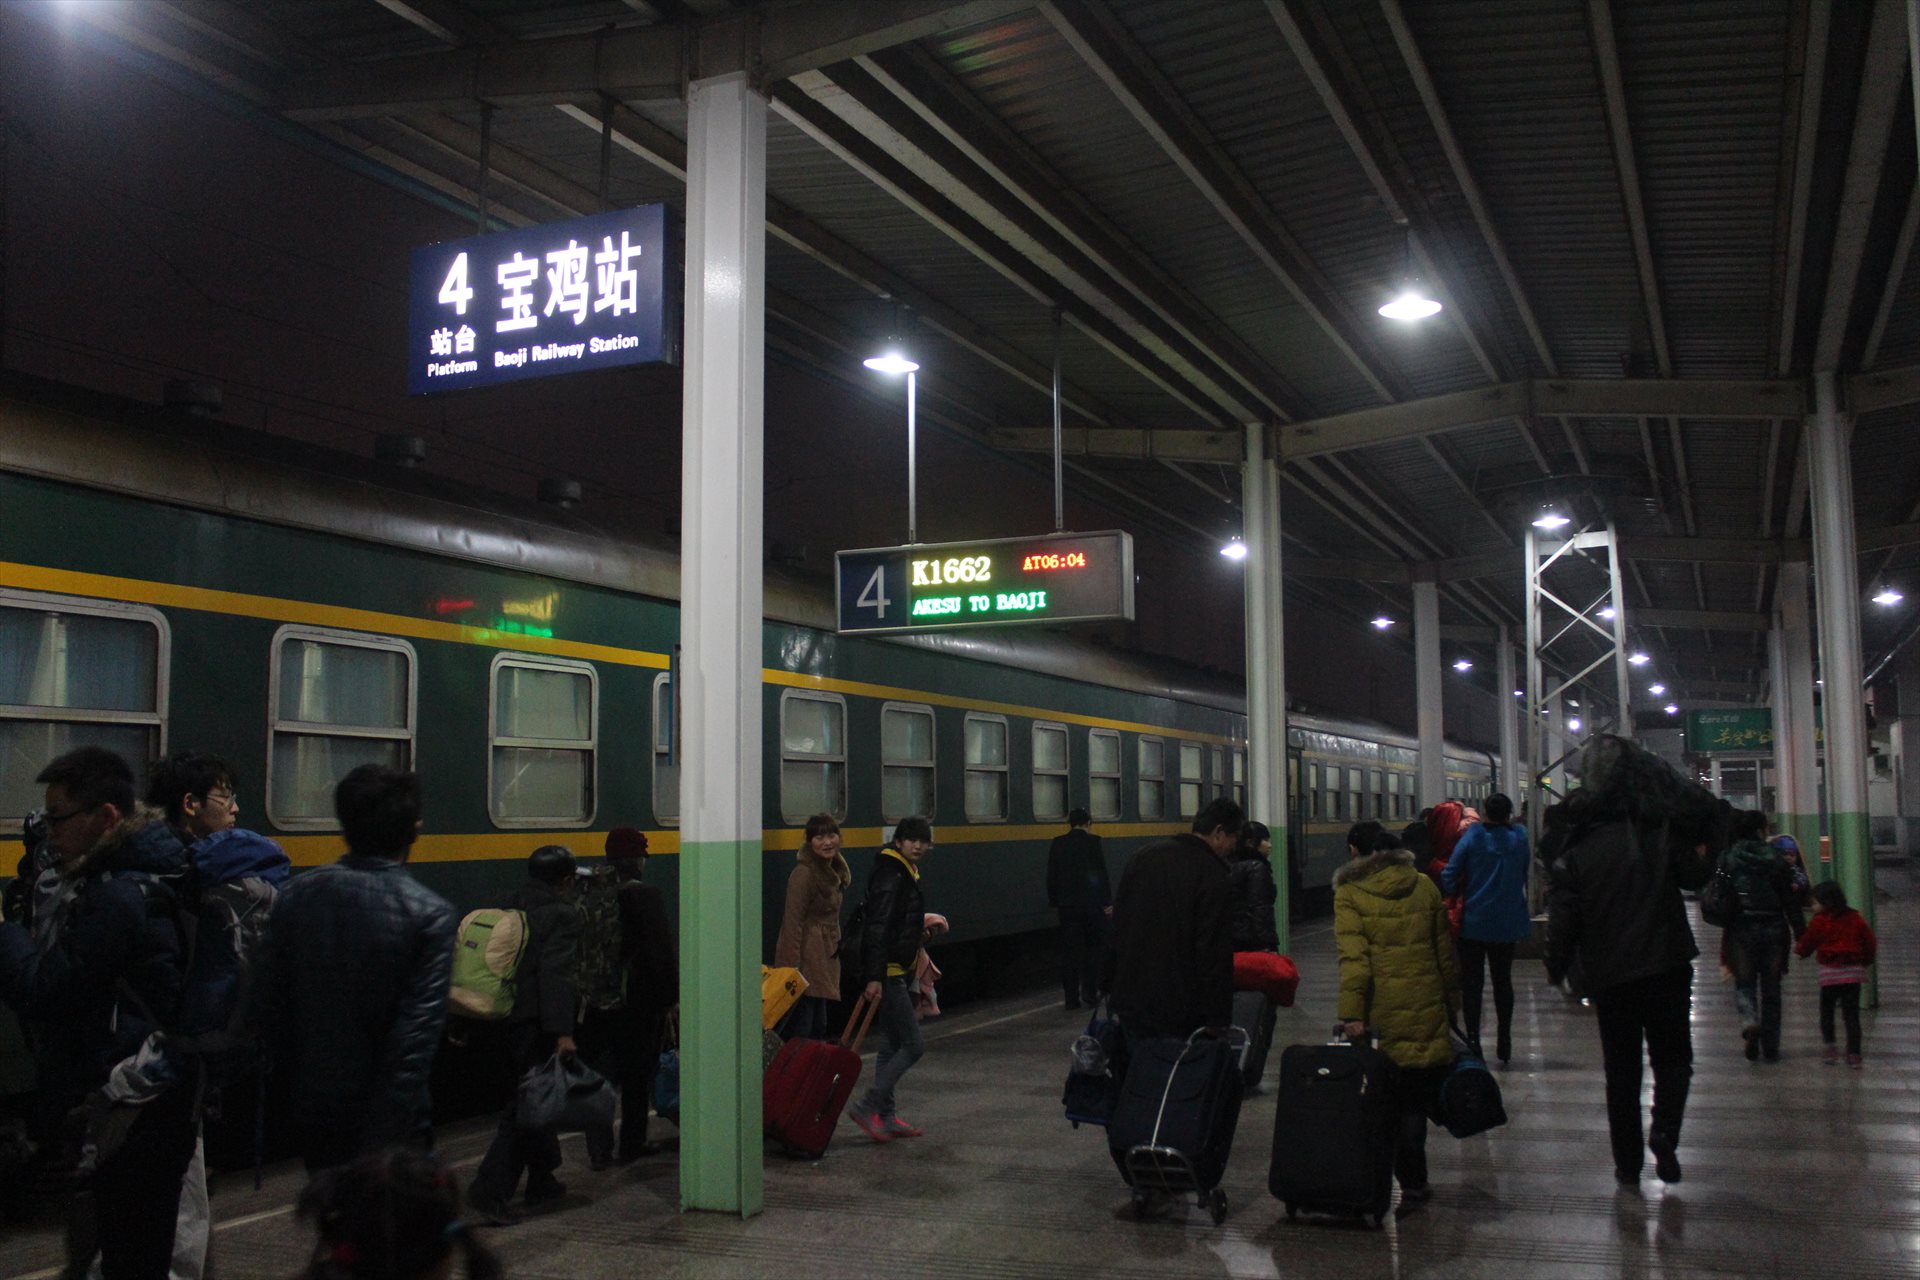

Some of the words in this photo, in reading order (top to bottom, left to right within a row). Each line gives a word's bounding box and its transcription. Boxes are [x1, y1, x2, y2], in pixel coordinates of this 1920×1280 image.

[438, 252, 473, 315] 4
[496, 231, 642, 333] 宝鸡站
[430, 325, 476, 356] 站台
[494, 350, 527, 368] Baoji
[532, 343, 585, 362] Railway
[589, 334, 638, 354] Station
[427, 360, 478, 377] Platform
[912, 556, 991, 585] K1662
[1023, 553, 1086, 570] AT06:04
[857, 565, 891, 619] 4
[912, 597, 961, 615] AKESU
[969, 595, 990, 612] TO
[996, 591, 1047, 611] BAOJI
